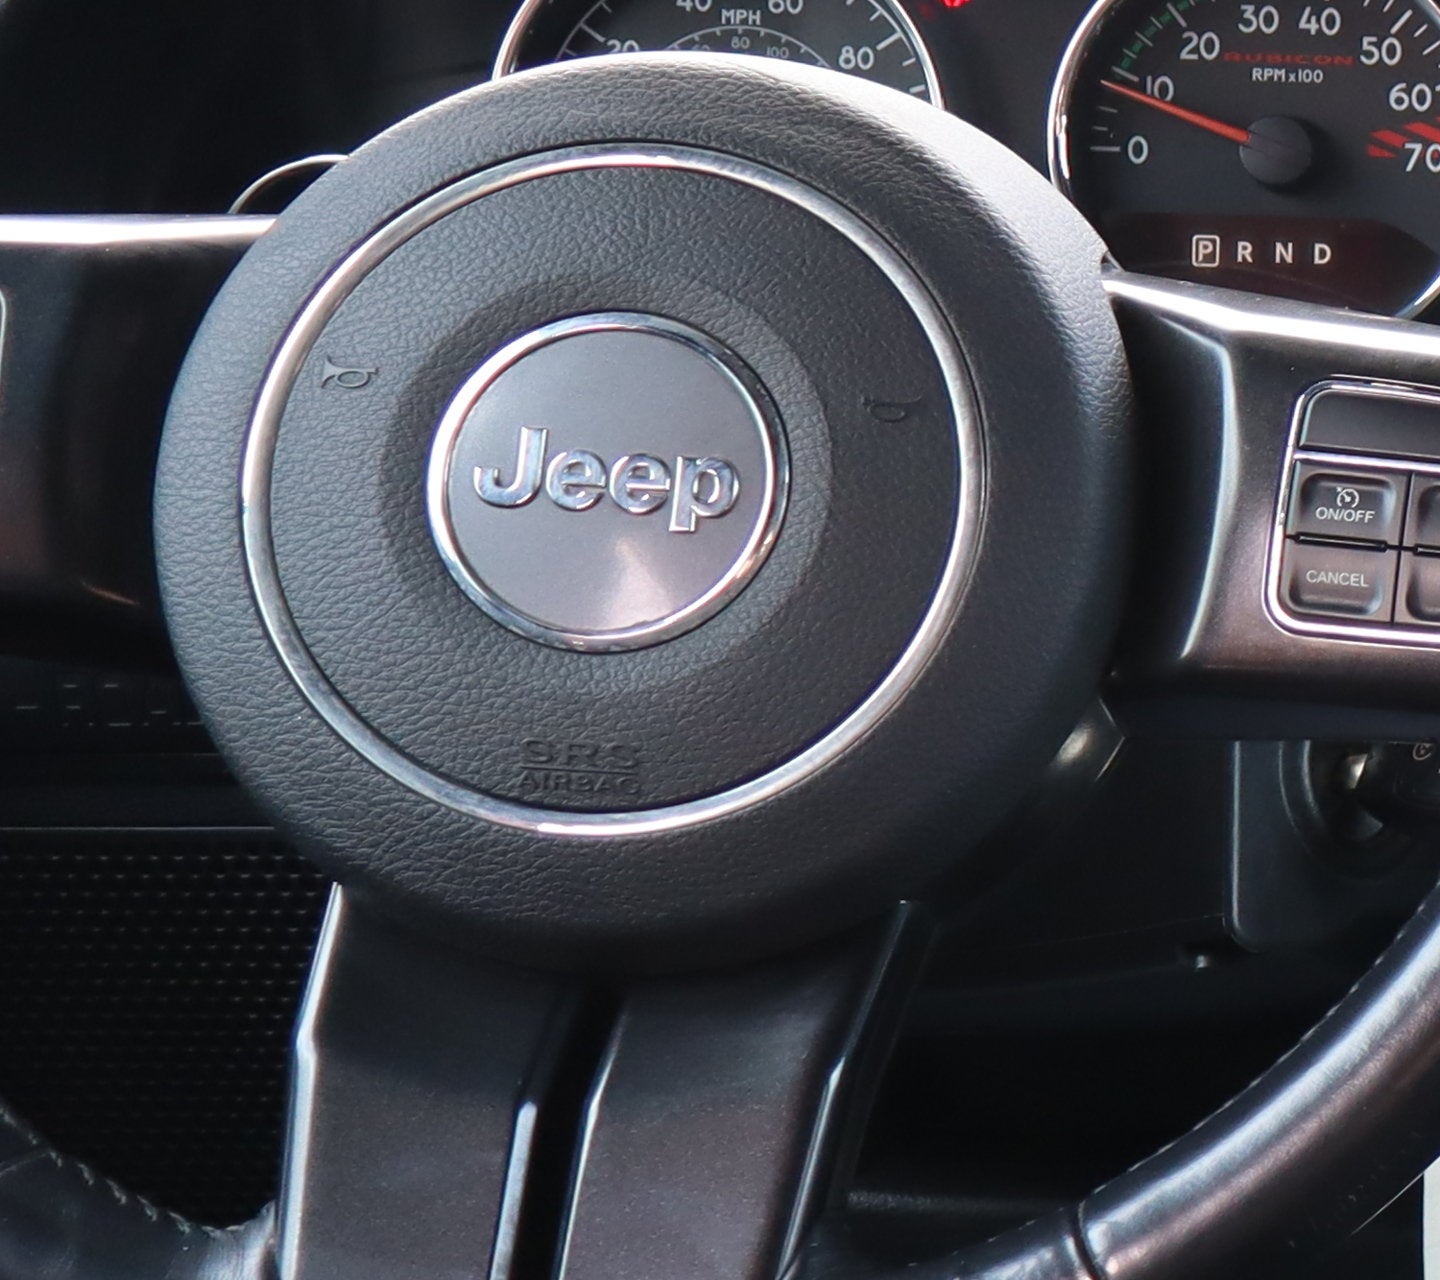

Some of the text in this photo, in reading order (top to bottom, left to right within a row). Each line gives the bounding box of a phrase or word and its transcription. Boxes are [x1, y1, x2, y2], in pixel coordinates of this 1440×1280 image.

[721, 8, 762, 26] MPH
[1238, 4, 1280, 35] 30
[1298, 6, 1342, 36] 40
[731, 36, 750, 50] 80
[766, 46, 790, 59] 100
[1179, 31, 1221, 61] 20
[1359, 36, 1403, 66] 50
[837, 45, 875, 70] 80
[1222, 51, 1355, 67] RUBICON
[1251, 67, 1287, 83] RPM
[1145, 75, 1175, 103] 10
[1388, 82, 1433, 112] 60
[1126, 135, 1149, 165] 0
[1197, 240, 1332, 265] P R N D
[472, 425, 741, 533] Jeep
[1315, 506, 1376, 524] ON/OFF
[1306, 569, 1370, 589] CANCEL
[520, 736, 638, 769] SRS
[517, 770, 642, 796] AIRBAG
